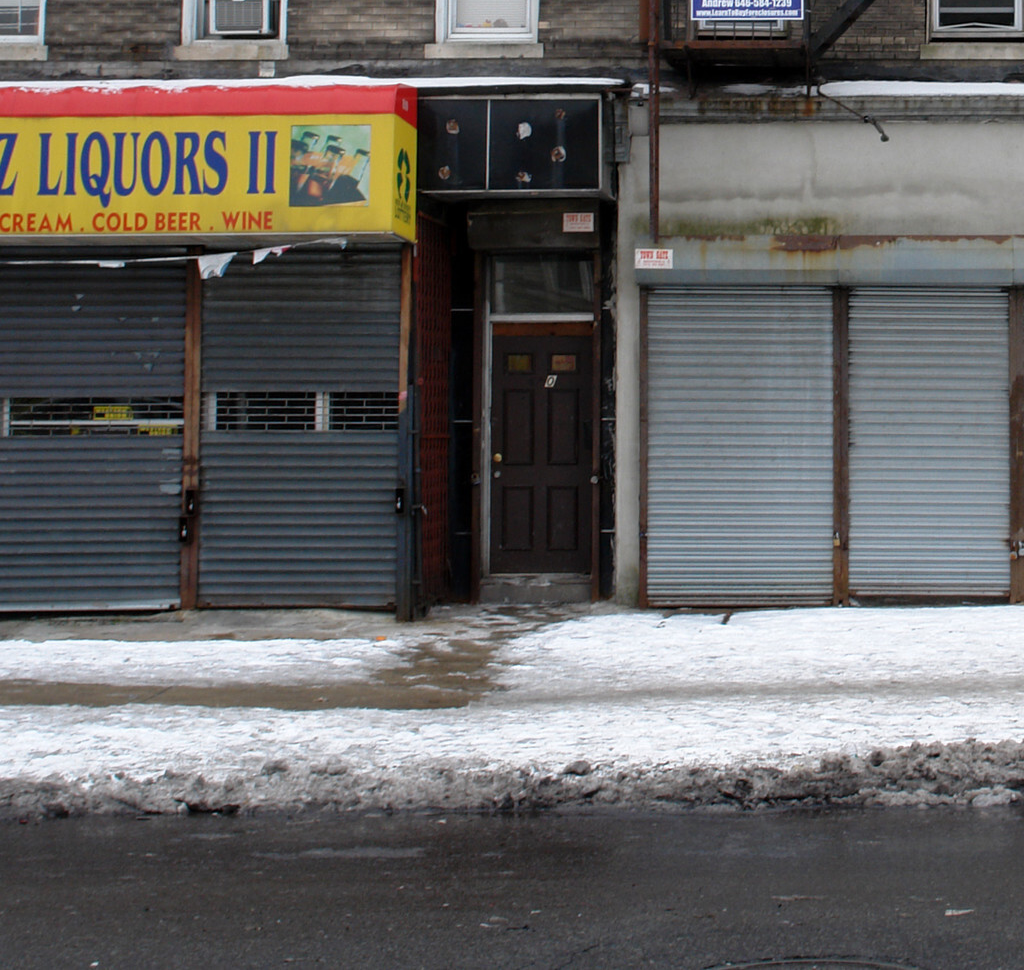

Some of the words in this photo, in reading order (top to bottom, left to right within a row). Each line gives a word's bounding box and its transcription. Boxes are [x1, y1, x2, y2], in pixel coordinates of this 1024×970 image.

[37, 130, 228, 208] LIQUORS
[246, 131, 278, 194] II
[0, 212, 73, 232] CREAM
[92, 212, 148, 232] COLD
[155, 212, 202, 230] BEER
[222, 211, 273, 230] WINE
